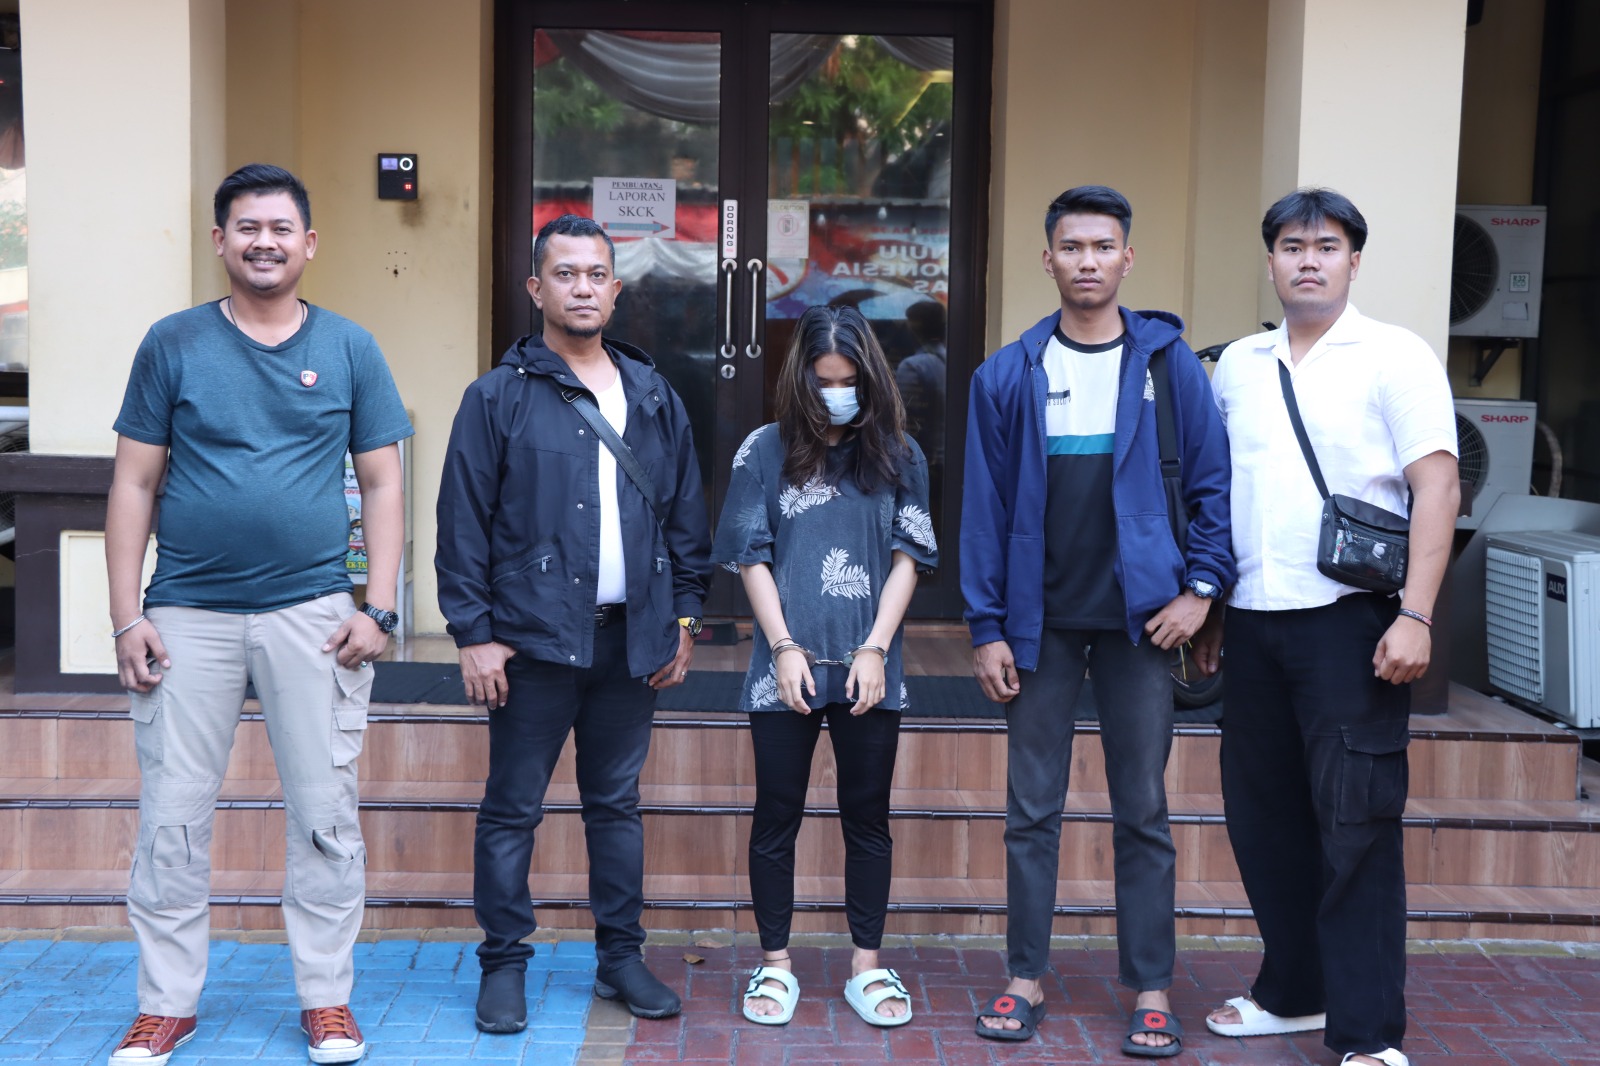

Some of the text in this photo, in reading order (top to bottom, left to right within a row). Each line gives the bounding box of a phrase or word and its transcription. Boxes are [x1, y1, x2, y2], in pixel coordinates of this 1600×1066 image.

[609, 191, 666, 202] LAPORAN
[618, 205, 655, 218] SKCK
[726, 205, 735, 247] DORONG
[1491, 217, 1540, 226] SHARP
[1480, 414, 1529, 423] SHARP
[1548, 580, 1566, 597] AUX
